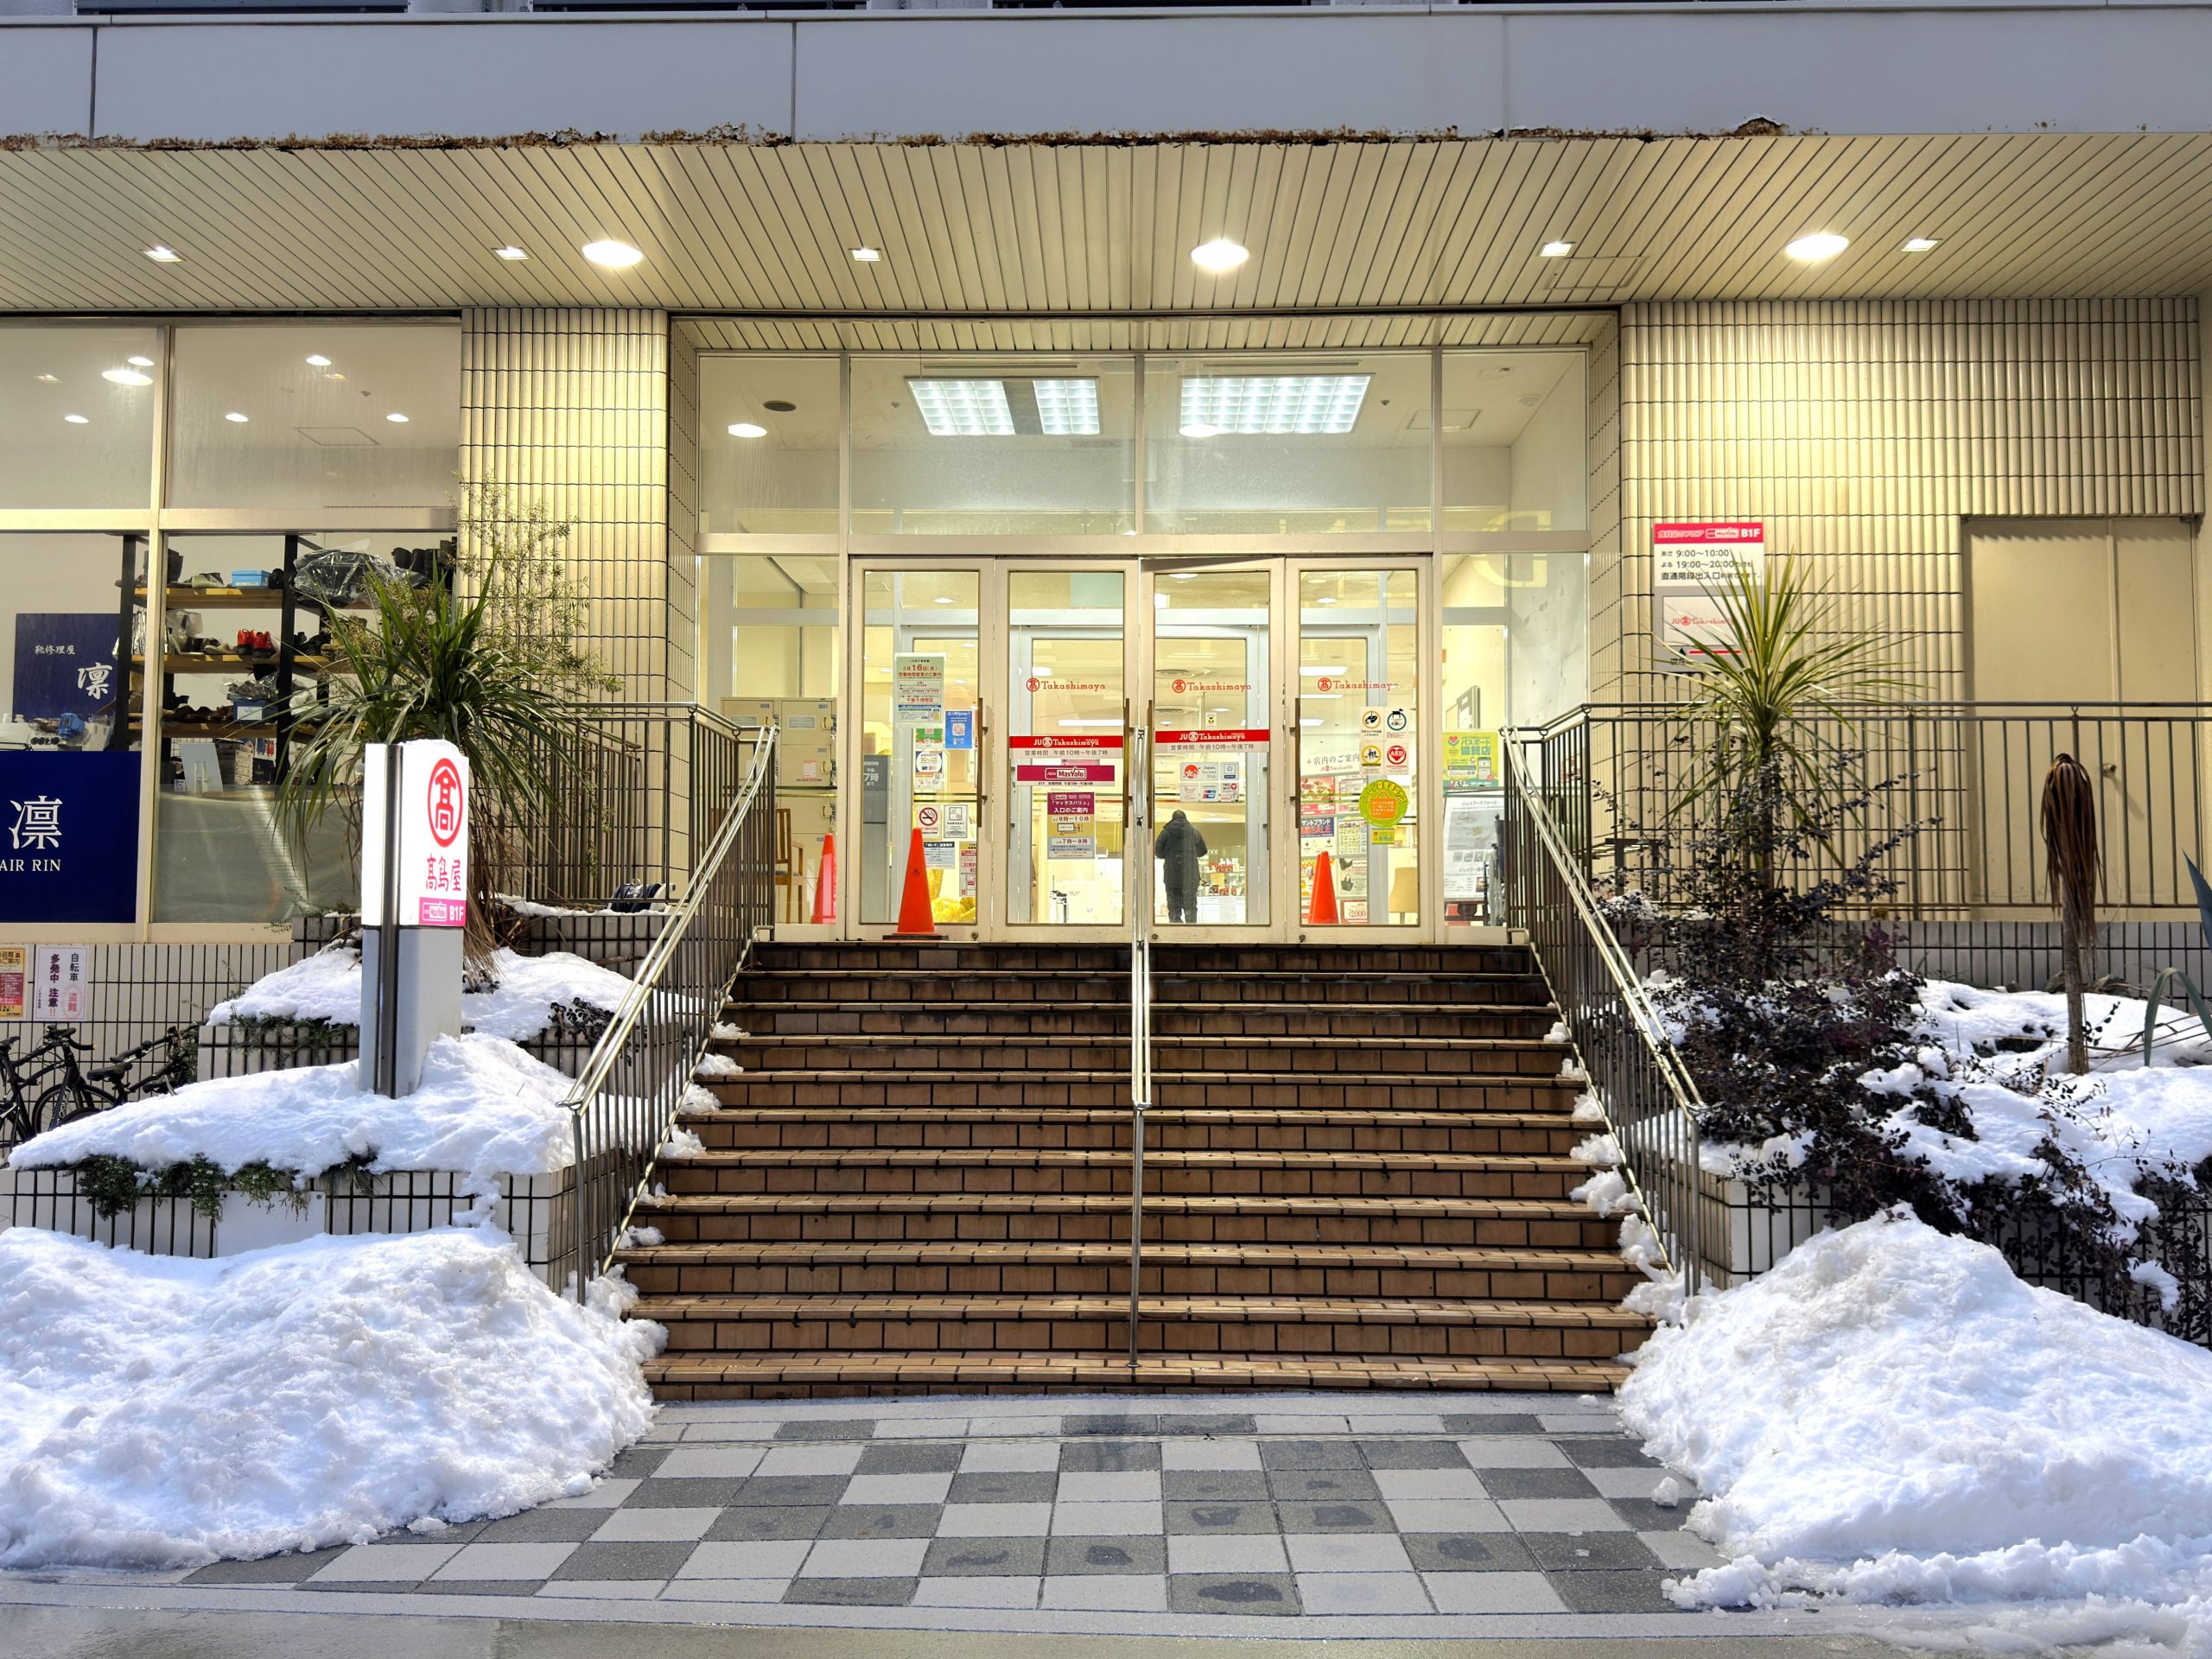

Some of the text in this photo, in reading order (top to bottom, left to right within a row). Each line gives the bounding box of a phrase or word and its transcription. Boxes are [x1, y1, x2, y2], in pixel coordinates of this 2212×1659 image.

[1740, 528, 1761, 538] B1F
[35, 645, 75, 655] 靴修理屋
[1041, 681, 1105, 692] Takashimaya
[1187, 682, 1252, 693] Takashimaya
[1198, 733, 1245, 741] Takashimaya
[1053, 739, 1099, 747] Takashimaya
[1058, 766, 1084, 778] MaxValu
[0, 859, 61, 872] AIR RIN
[449, 906, 464, 922] B1F
[49, 953, 60, 983] 多発中
[69, 952, 79, 982] 自転車
